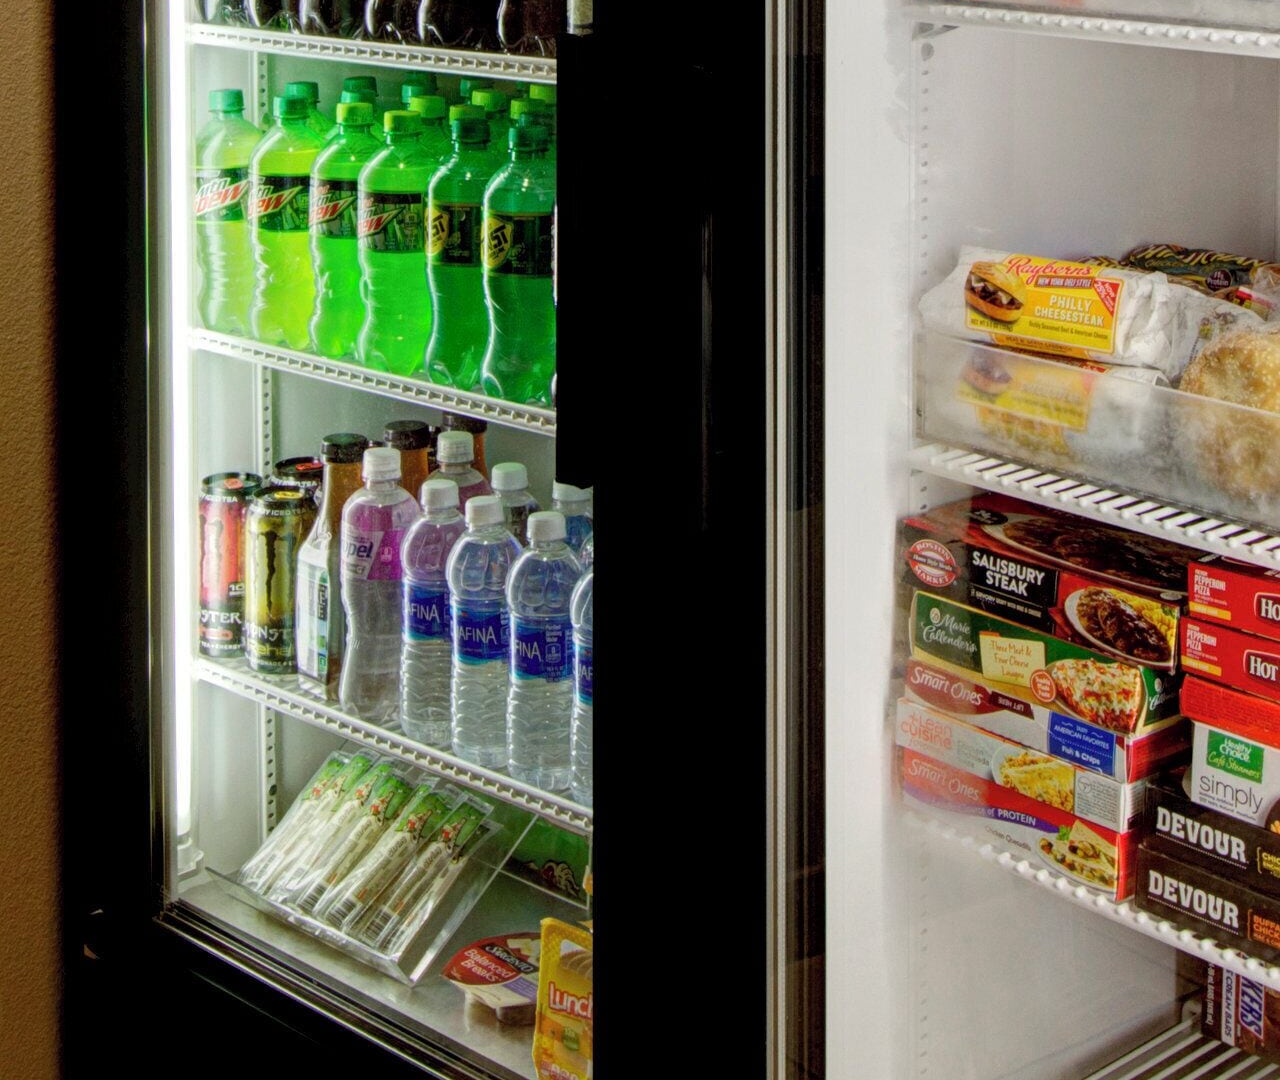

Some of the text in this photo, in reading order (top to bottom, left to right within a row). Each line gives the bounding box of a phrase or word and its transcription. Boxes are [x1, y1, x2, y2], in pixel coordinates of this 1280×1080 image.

[1049, 295, 1093, 312] PHILLY
[1035, 306, 1105, 327] CHEESESTEAK
[916, 540, 951, 561] BOSTON
[914, 565, 949, 585] MARKET
[972, 550, 1046, 586] SALISBURY
[985, 571, 1029, 596] STEAK
[1194, 575, 1226, 591] PEPPERONI
[1194, 585, 1211, 597] PIZZA
[940, 614, 970, 634] Marie
[921, 625, 978, 653] Callender's
[1186, 630, 1217, 647] PEPPERONI
[1186, 639, 1202, 651] PIZZA
[1249, 655, 1280, 681] HOT
[910, 666, 983, 706] Smart Ones
[1219, 745, 1250, 761] Choice
[1224, 738, 1252, 754] Healthy
[1081, 753, 1101, 766] Chips
[909, 758, 980, 801] Smart Ones
[1199, 775, 1264, 814] simply
[997, 808, 1037, 826] PROTEIN
[1156, 806, 1246, 863] DEVOUR
[1148, 870, 1239, 928] DEVOUR
[460, 959, 498, 982] Breaks
[464, 948, 516, 979] Balanced
